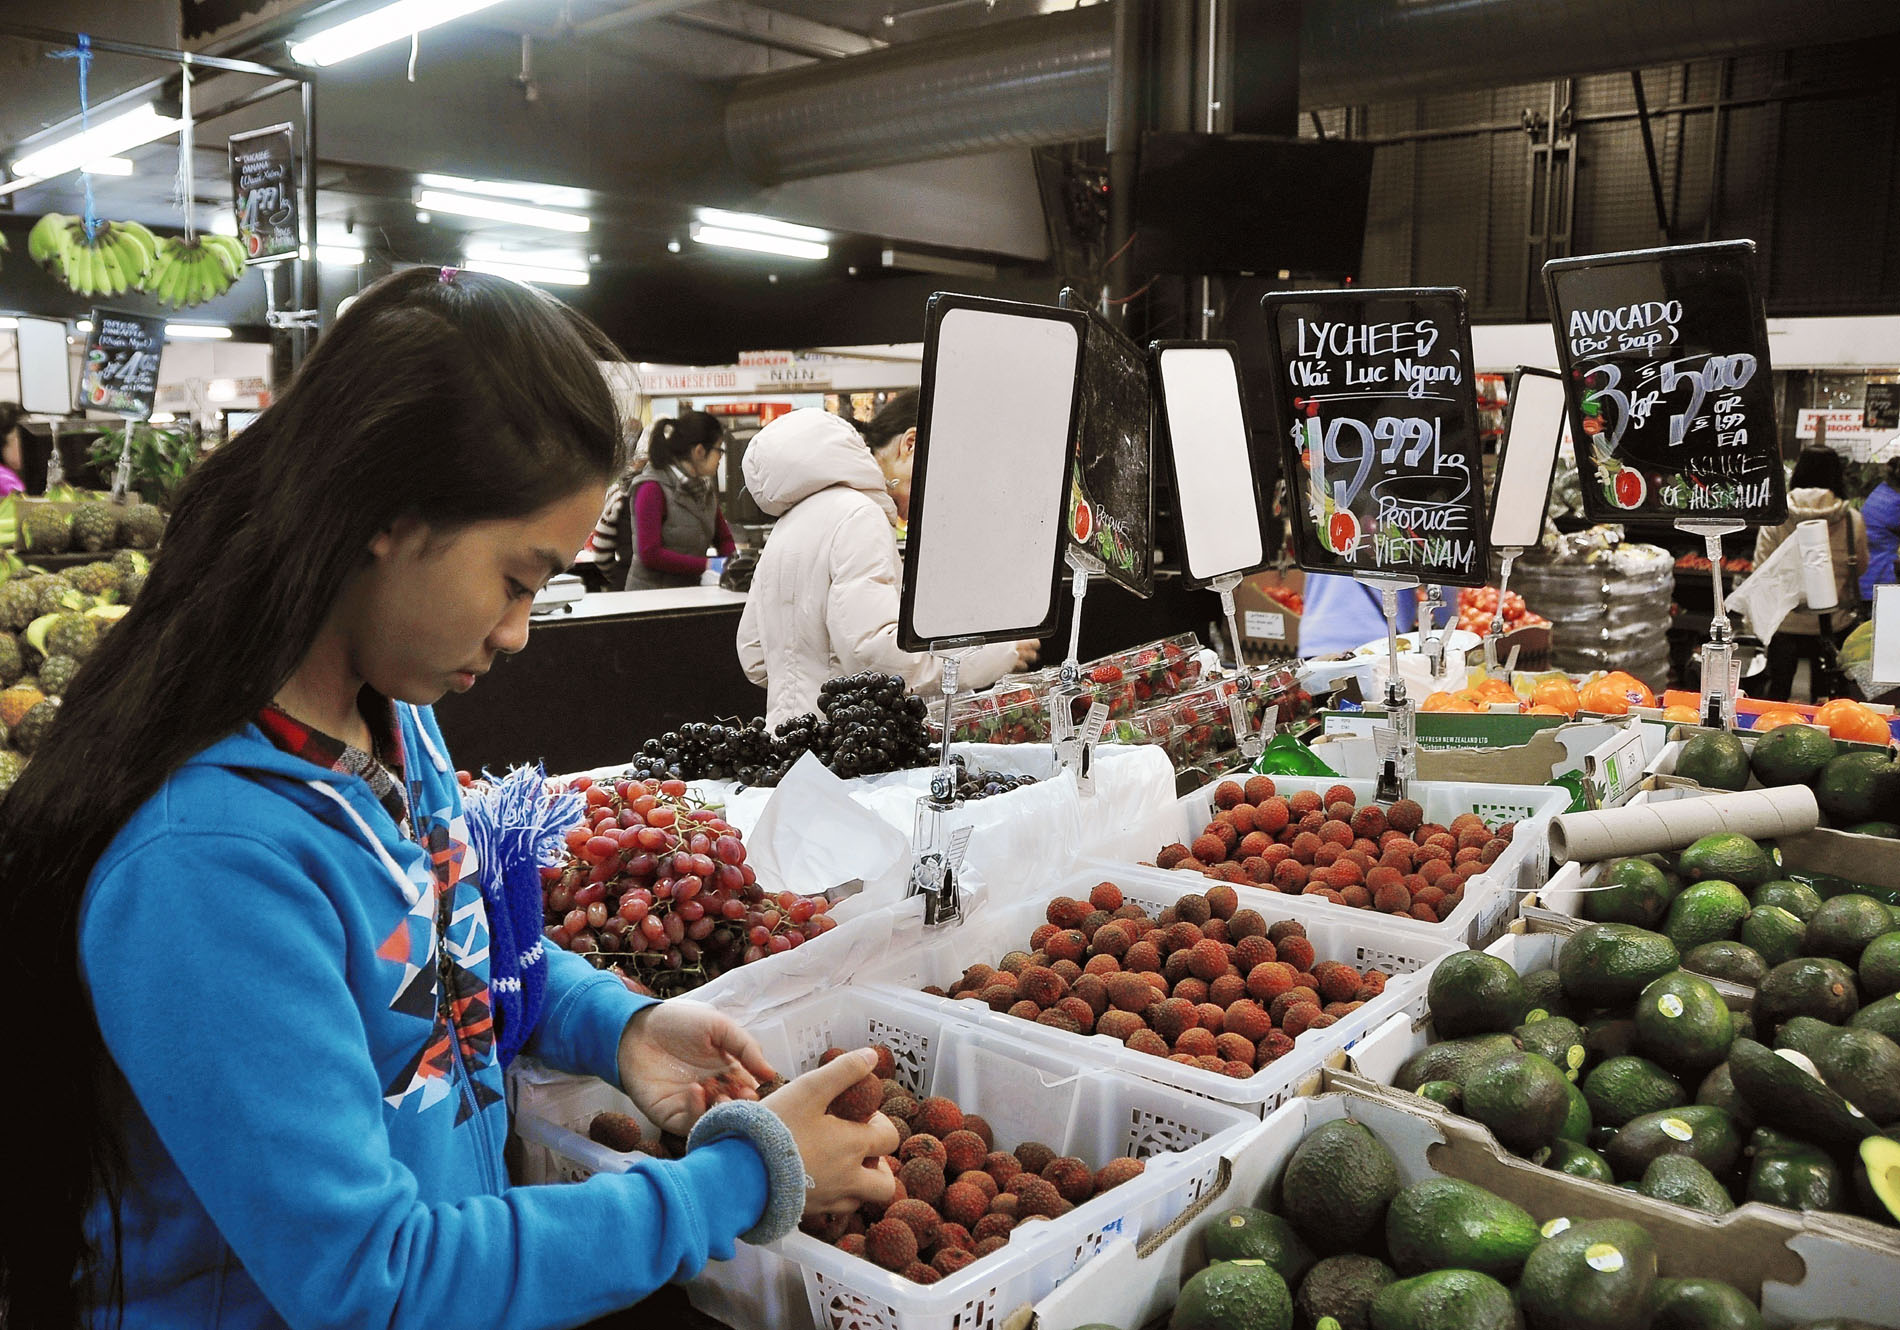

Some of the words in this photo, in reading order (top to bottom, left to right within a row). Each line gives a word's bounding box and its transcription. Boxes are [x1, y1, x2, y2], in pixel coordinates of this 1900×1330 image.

[1570, 300, 1683, 337] AVOCADO
[1298, 318, 1438, 359] LYCHEES
[706, 372, 737, 388] FOOD
[1583, 364, 1631, 461] 3
[1714, 393, 1745, 413] OR
[1717, 428, 1749, 448] EA
[1376, 496, 1473, 533] PRODUCE
[1344, 534, 1372, 563] OF
[1455, 736, 1477, 744] ZEALAND
